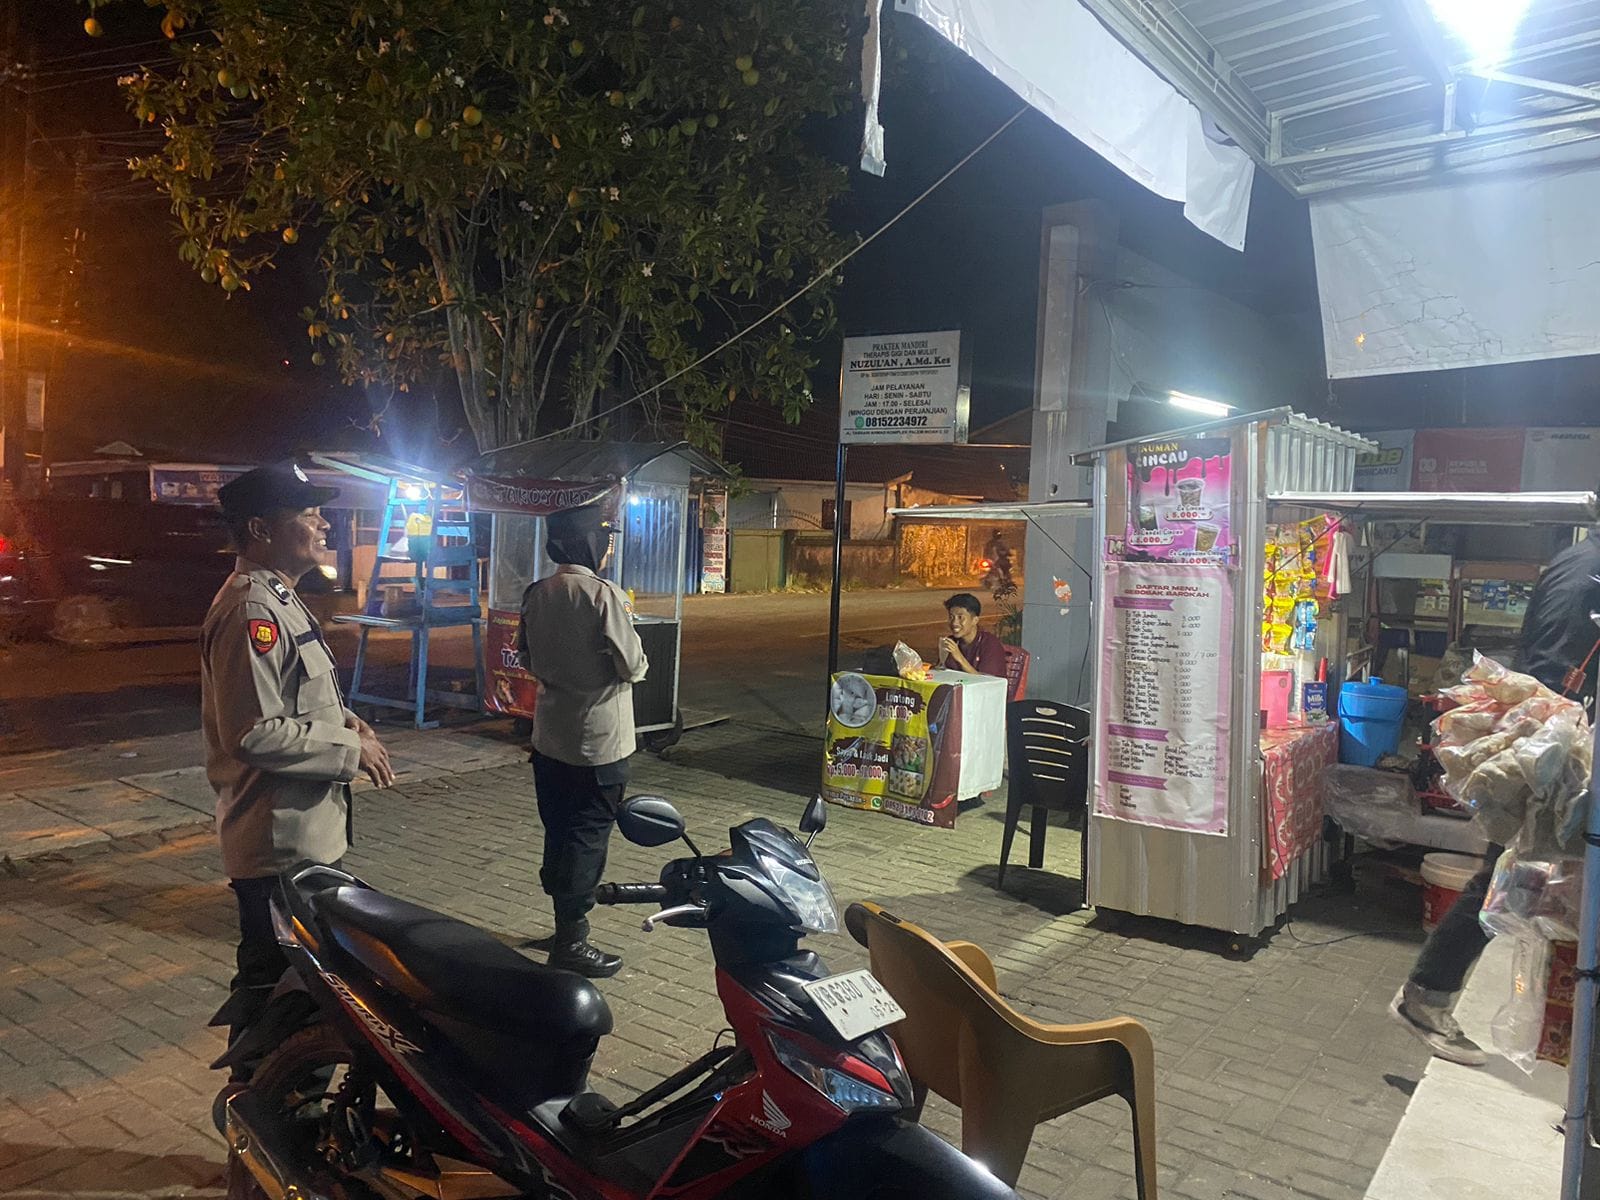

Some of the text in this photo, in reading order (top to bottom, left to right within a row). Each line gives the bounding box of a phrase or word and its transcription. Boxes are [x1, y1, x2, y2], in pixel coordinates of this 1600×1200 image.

[872, 340, 928, 351] PRAKTEK MANDIRI
[864, 349, 889, 358] THERAPIS
[918, 348, 937, 356] MULUT
[850, 358, 898, 369] NUZUL'AN
[934, 356, 950, 365] Kes
[886, 383, 925, 391] PELAYANAN
[848, 409, 875, 417] (MINGGU
[904, 407, 947, 415] PERJANJIAN)
[866, 416, 927, 427] 08152234972
[1136, 450, 1188, 467] CINCAU
[493, 486, 591, 506] TAKOYAKI
[885, 691, 915, 708] Lontong
[873, 752, 889, 763] Jadi
[750, 1113, 787, 1139] HONDA
